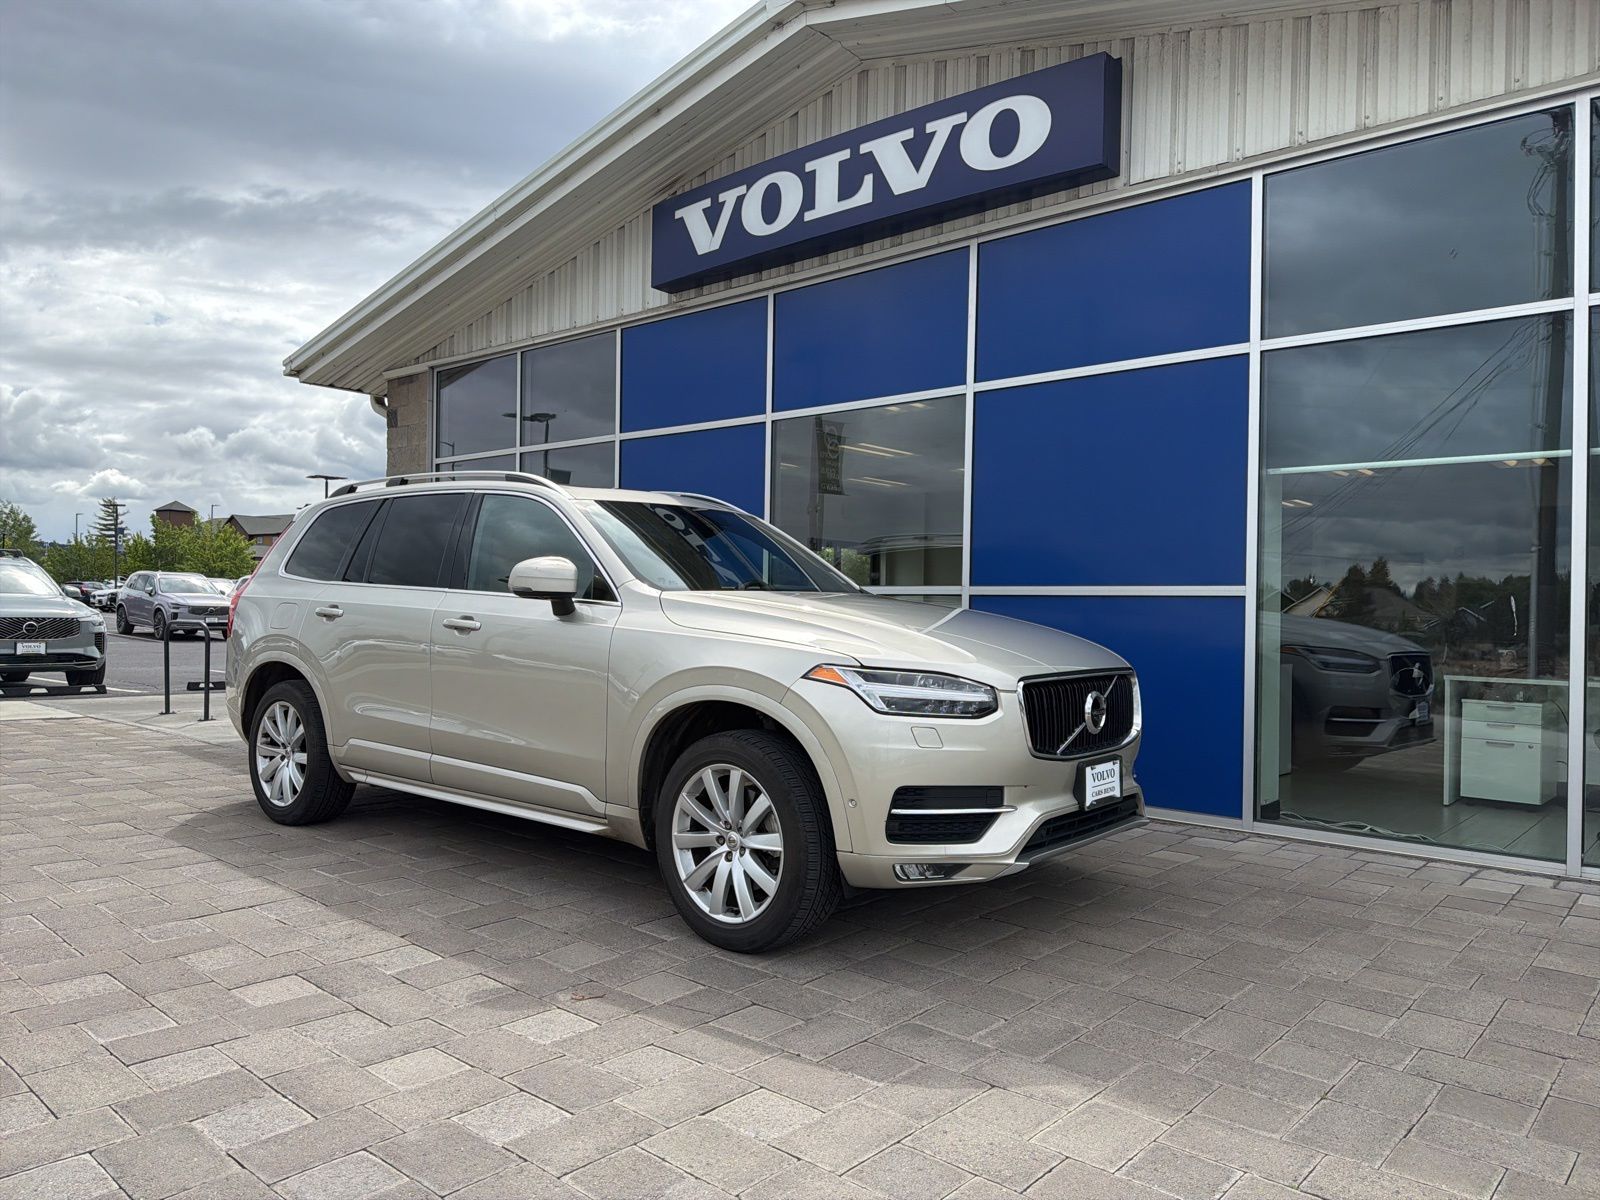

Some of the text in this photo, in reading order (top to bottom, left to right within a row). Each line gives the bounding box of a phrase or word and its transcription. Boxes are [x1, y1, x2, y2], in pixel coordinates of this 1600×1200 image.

[674, 95, 1052, 256] VOLVO
[1092, 768, 1116, 783] VOLVO
[1092, 786, 1116, 797] CARS BEND
